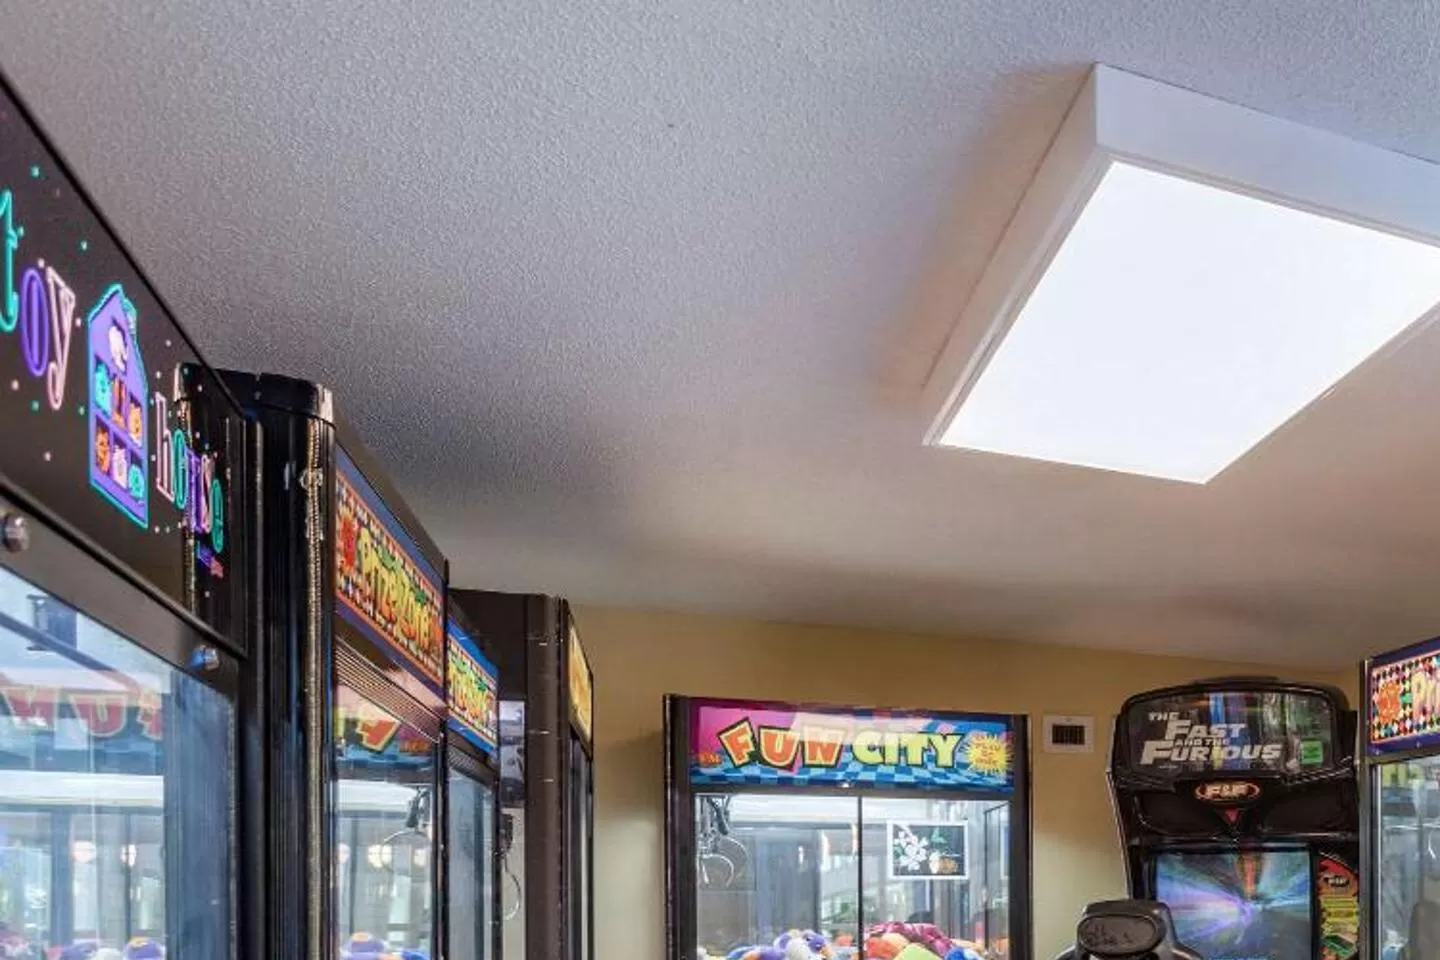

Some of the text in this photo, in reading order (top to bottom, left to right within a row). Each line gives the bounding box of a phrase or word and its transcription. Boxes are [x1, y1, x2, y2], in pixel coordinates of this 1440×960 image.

[1149, 711, 1180, 721] THE
[1165, 719, 1247, 740] FAST
[717, 716, 847, 772] FUN
[852, 730, 965, 768] CITY
[1140, 740, 1283, 765] FURIOUS
